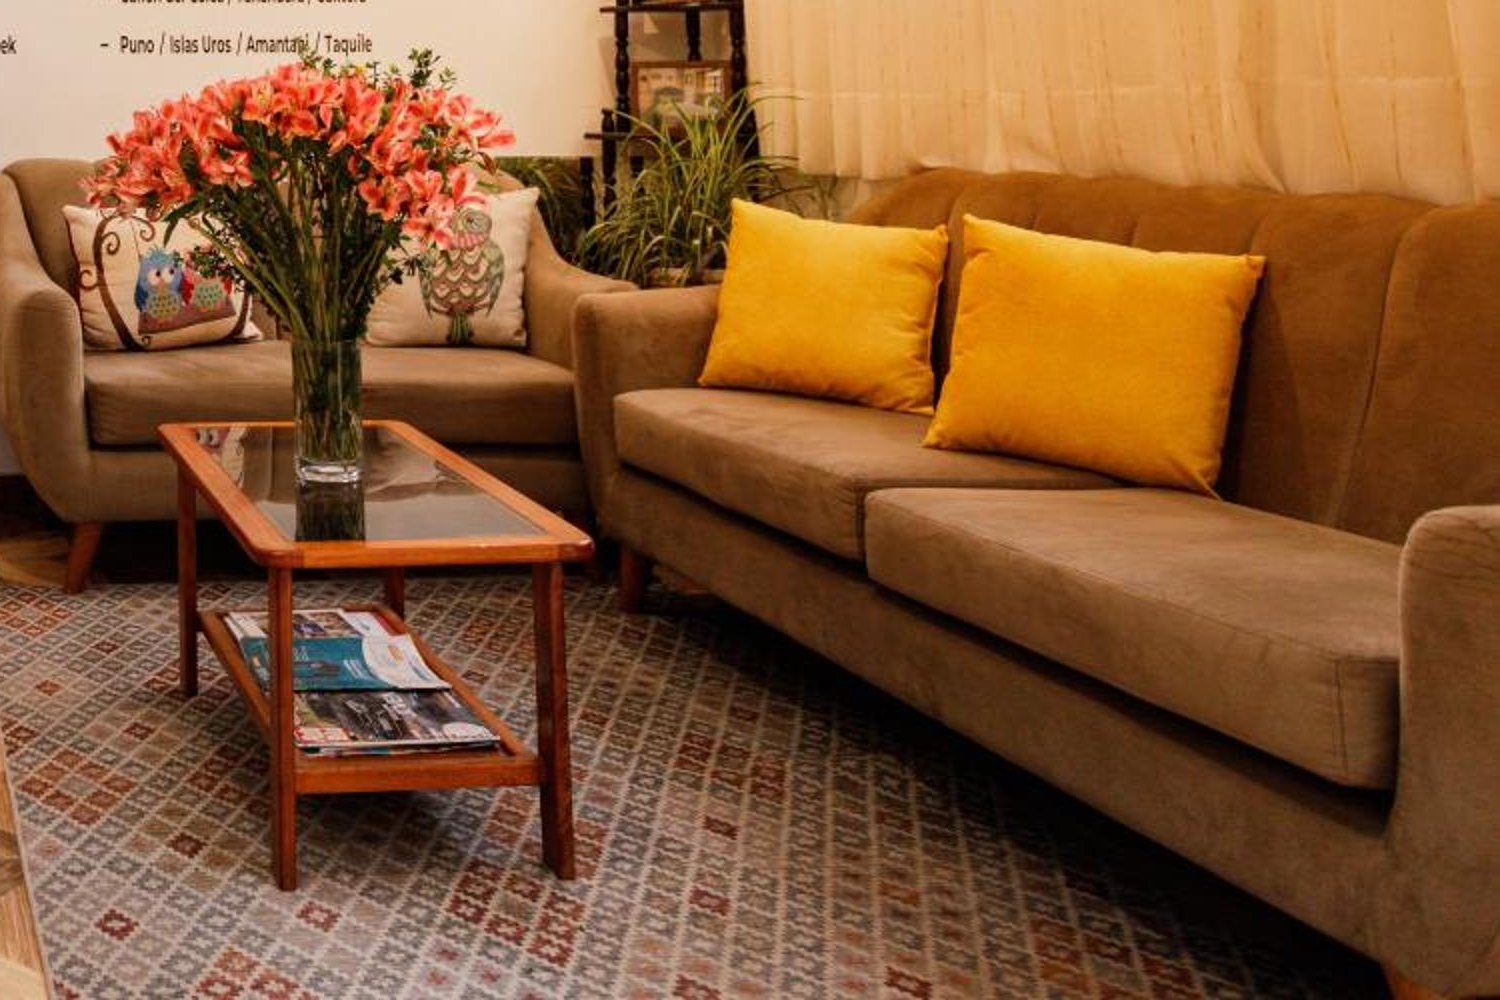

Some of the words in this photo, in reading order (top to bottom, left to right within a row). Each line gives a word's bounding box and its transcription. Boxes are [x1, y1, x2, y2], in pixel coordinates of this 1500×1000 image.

[120, 36, 155, 55] Puno
[169, 34, 199, 55] Islas
[201, 36, 232, 55] Uros
[324, 32, 373, 58] Taquile
